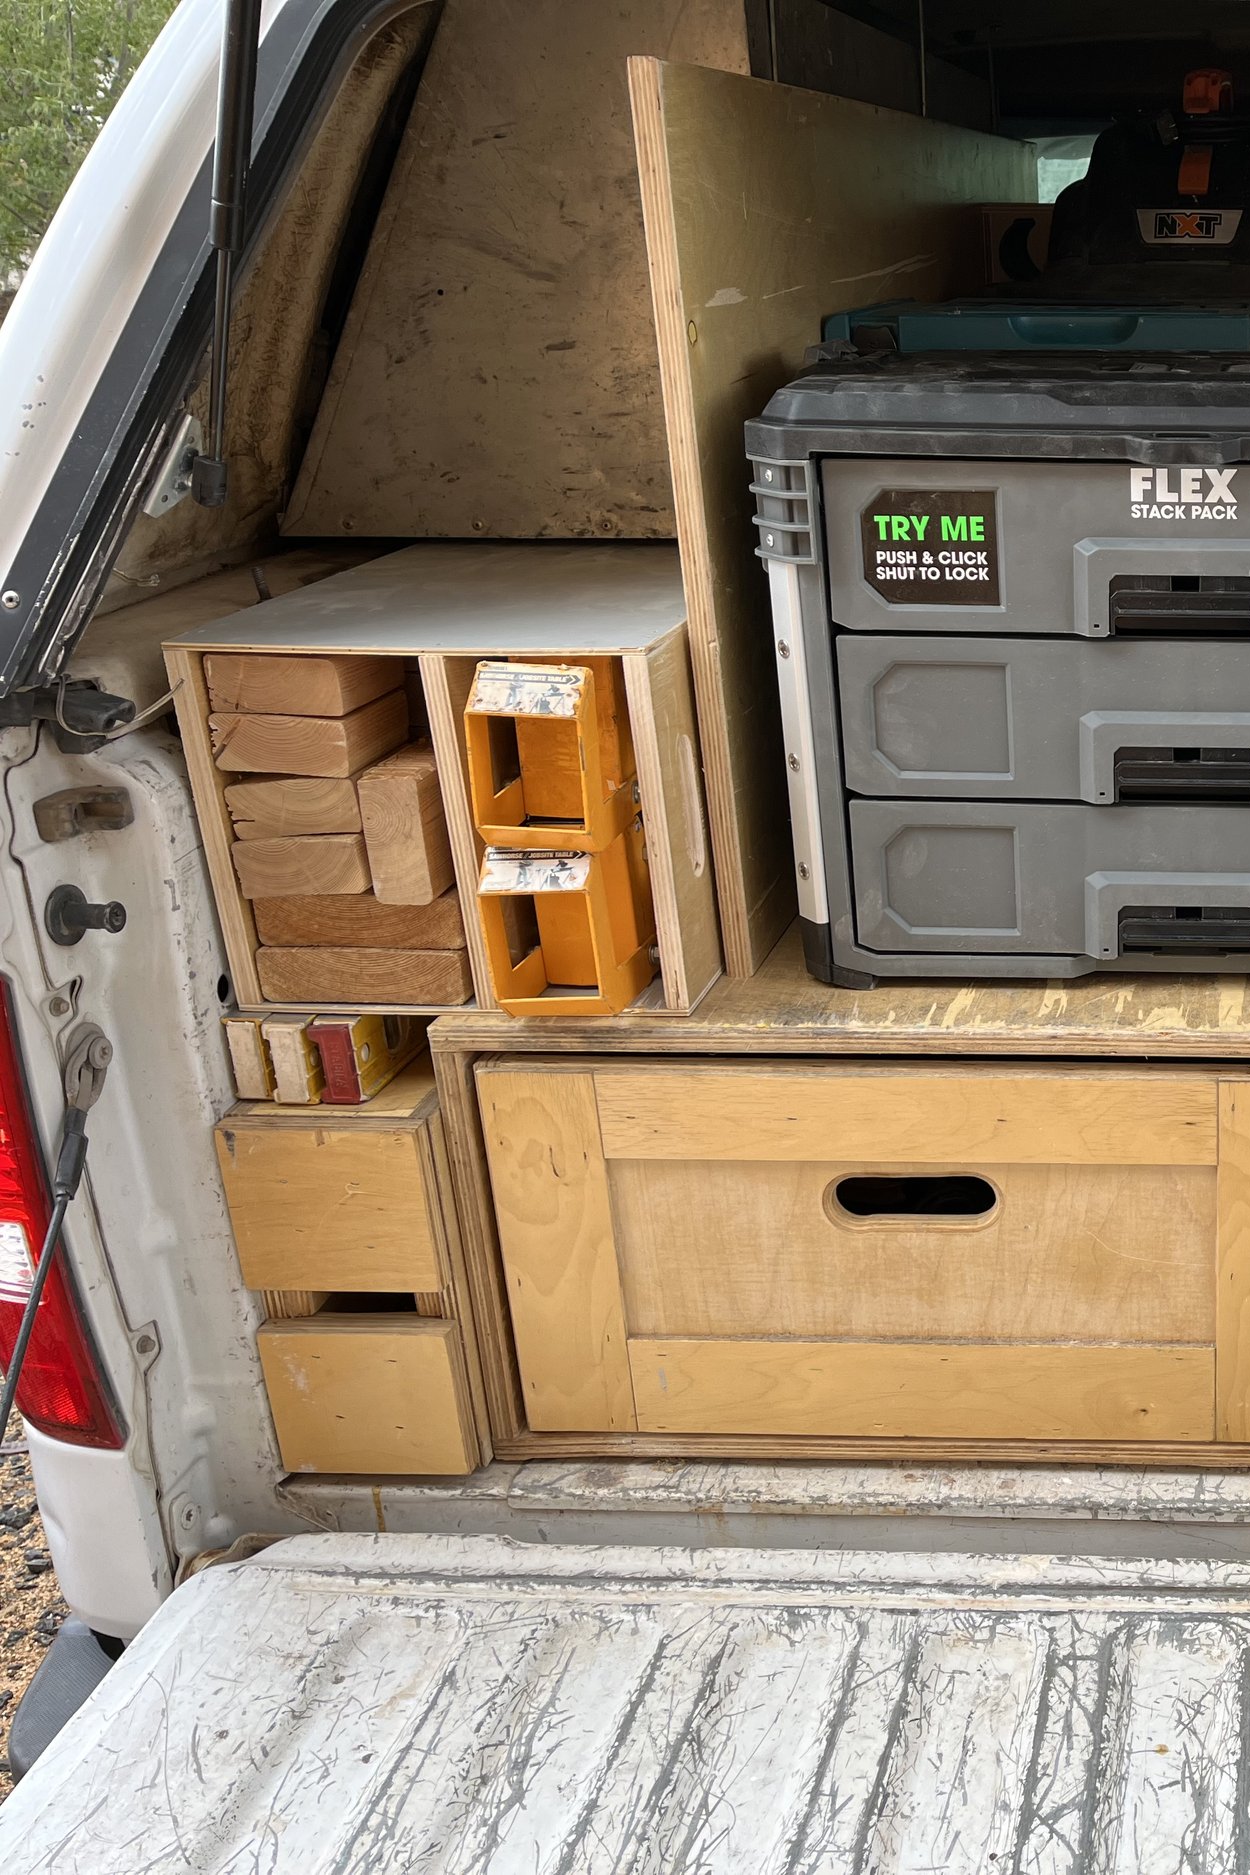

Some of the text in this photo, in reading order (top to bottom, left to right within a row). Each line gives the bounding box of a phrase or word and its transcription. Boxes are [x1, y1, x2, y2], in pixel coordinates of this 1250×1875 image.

[1154, 213, 1222, 238] NXT
[1131, 468, 1238, 503] FLEX
[1131, 504, 1238, 520] STACK PACK
[874, 515, 985, 542] TRY ME
[876, 550, 988, 566] PUSH & CLICK
[876, 566, 990, 581] SHUT TO LOCK
